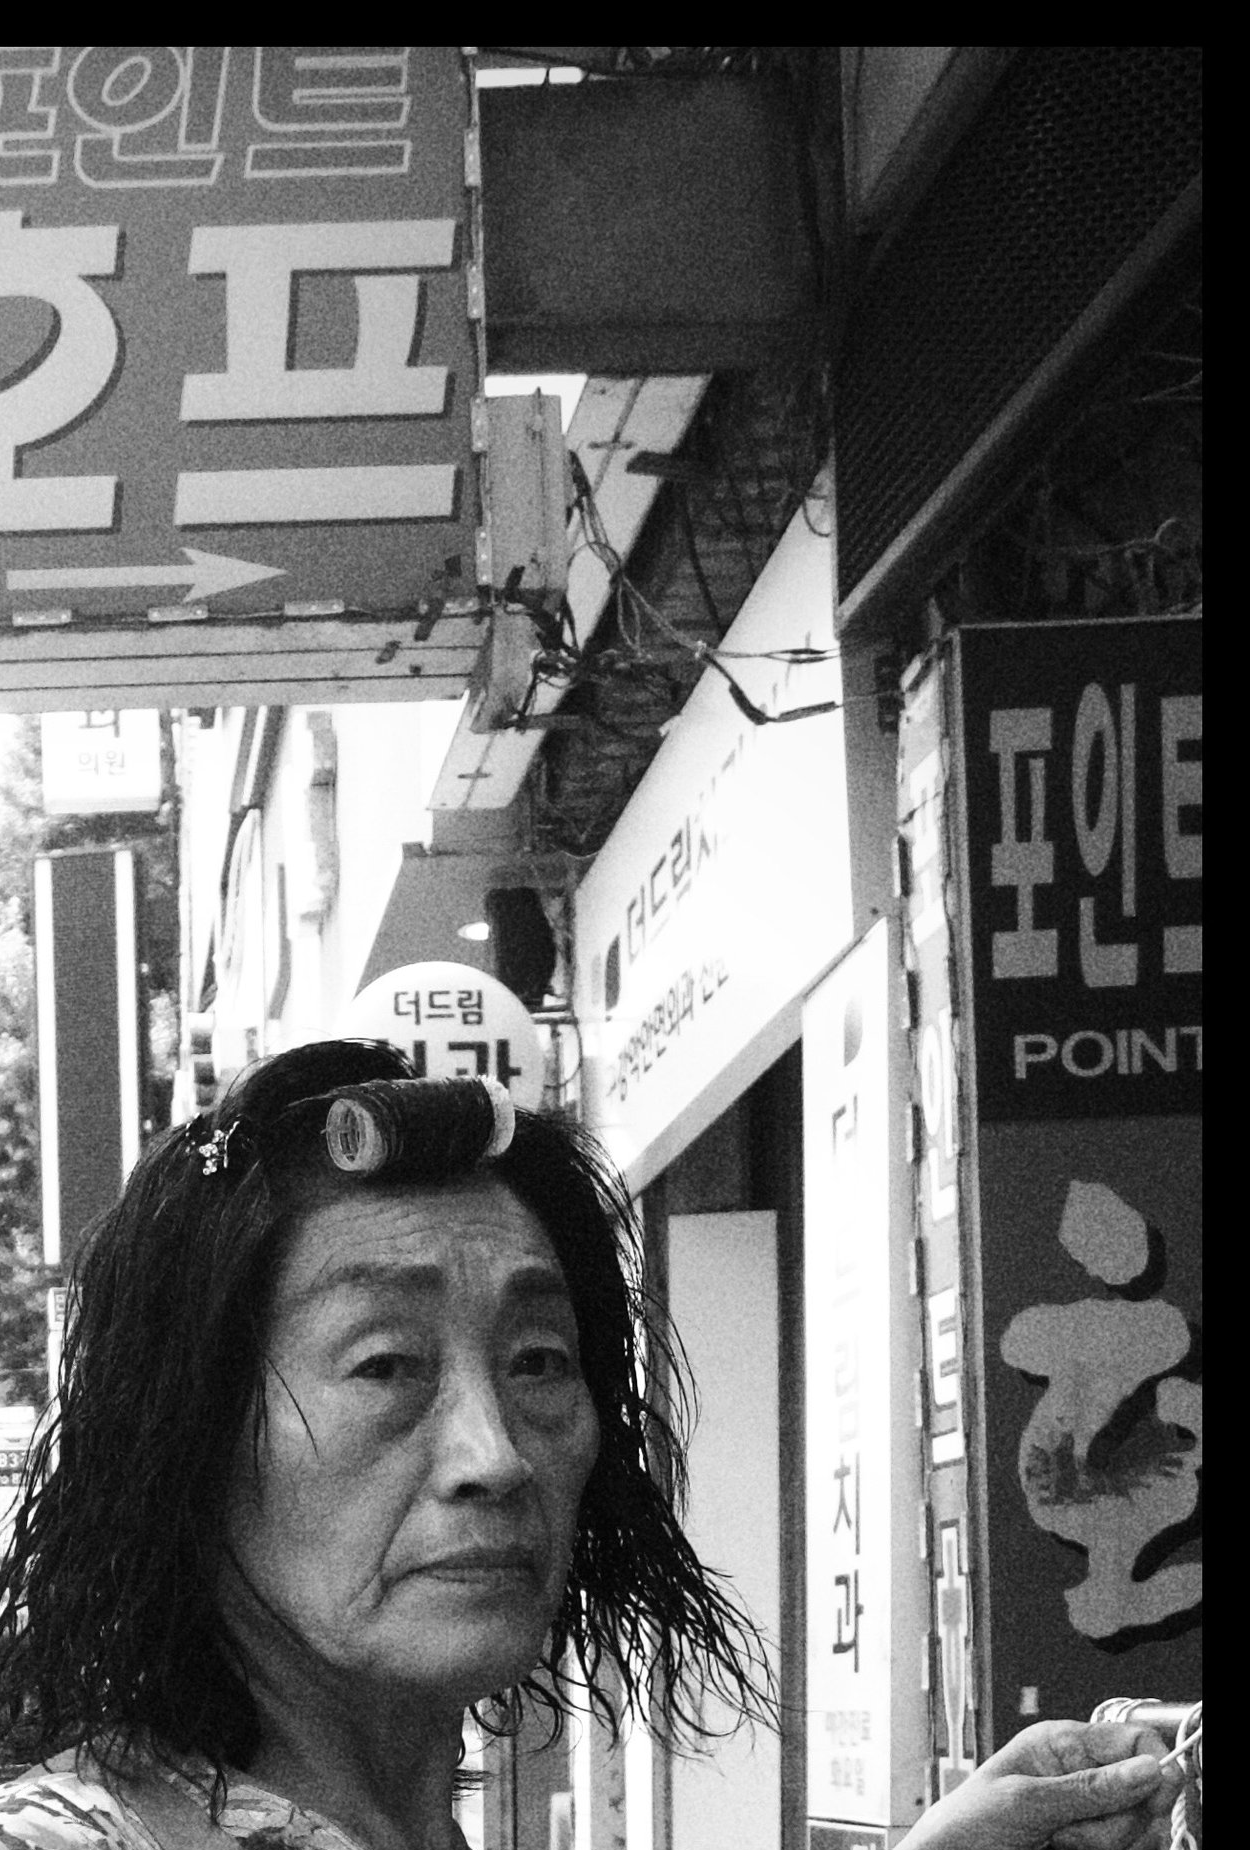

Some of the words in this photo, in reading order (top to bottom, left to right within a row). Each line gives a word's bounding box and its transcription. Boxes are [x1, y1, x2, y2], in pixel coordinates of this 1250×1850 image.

[984, 682, 1203, 990] 포인트
[393, 989, 483, 1026] 더드림
[1014, 1027, 1203, 1080] POINT
